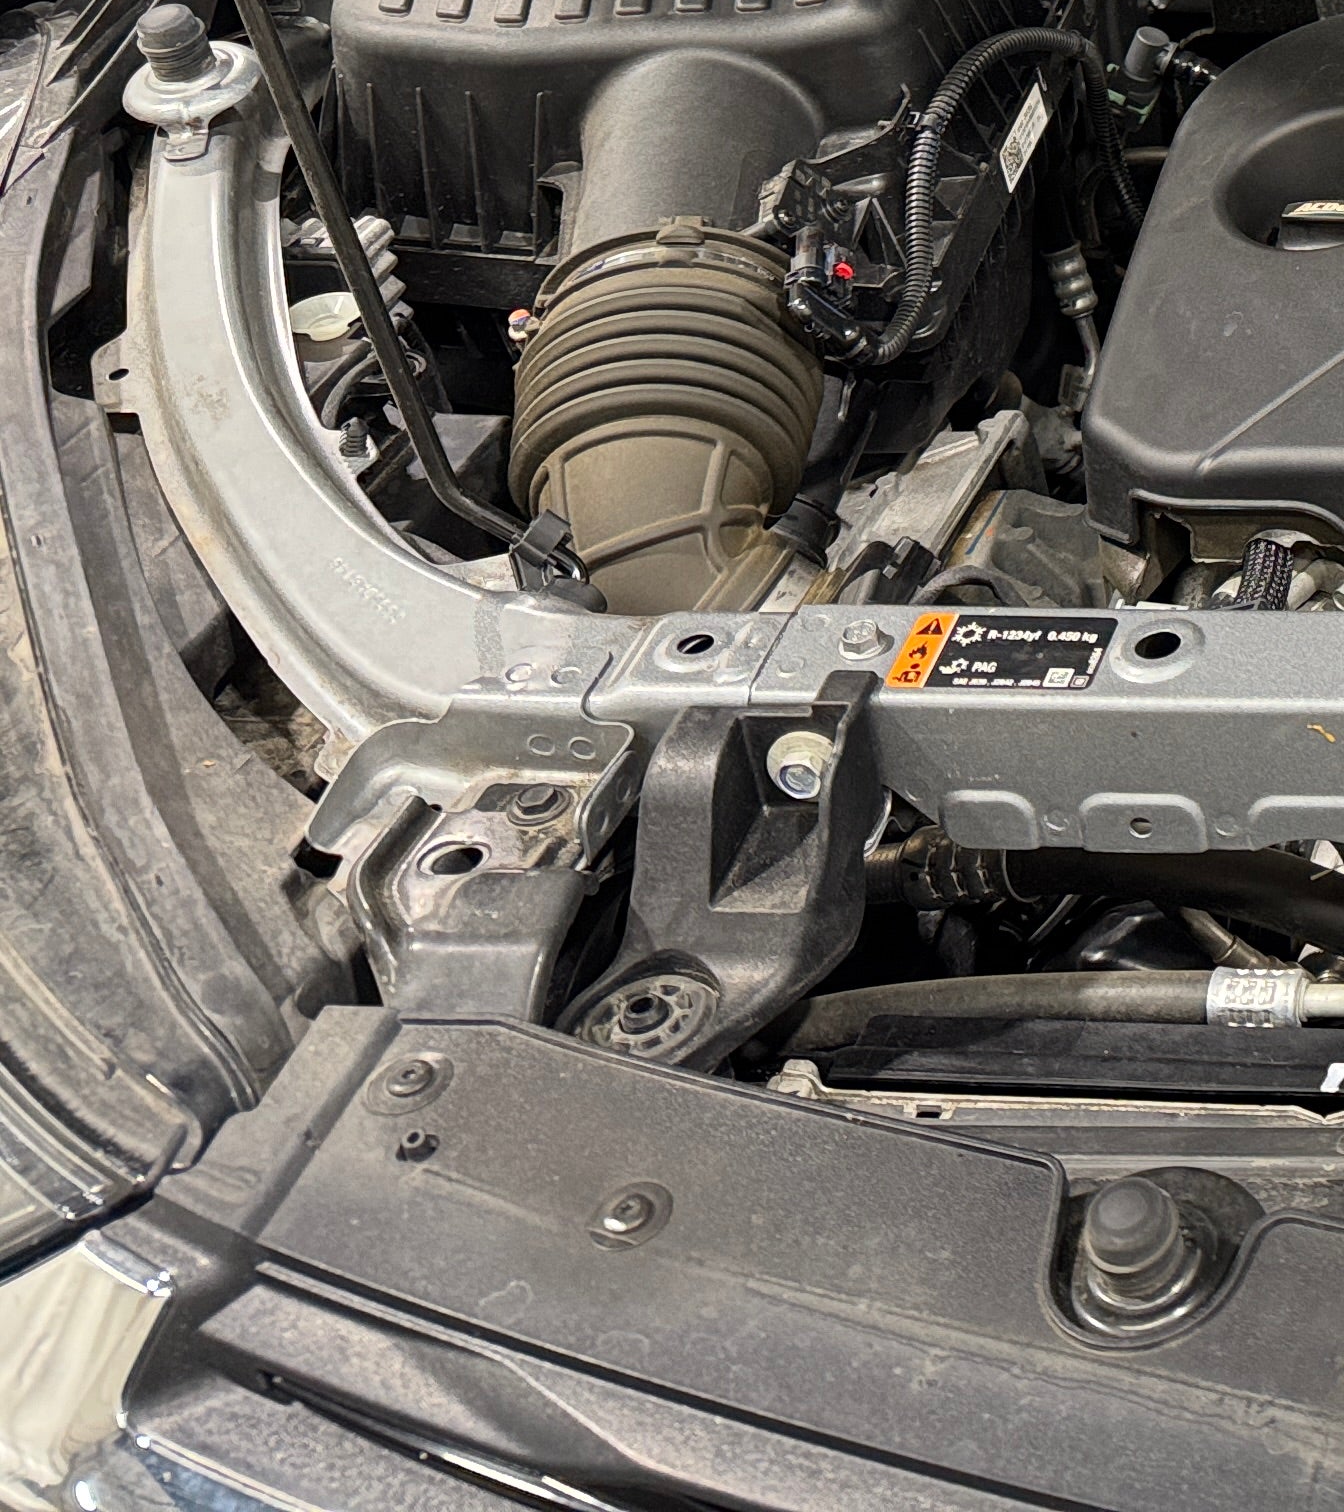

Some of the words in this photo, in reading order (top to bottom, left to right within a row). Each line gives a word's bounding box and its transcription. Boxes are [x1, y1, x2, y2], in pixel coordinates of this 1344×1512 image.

[987, 629, 1043, 642] R-1234yf
[1046, 630, 1081, 642] 0.450
[1081, 632, 1099, 644] kg
[971, 661, 998, 673] PAG
